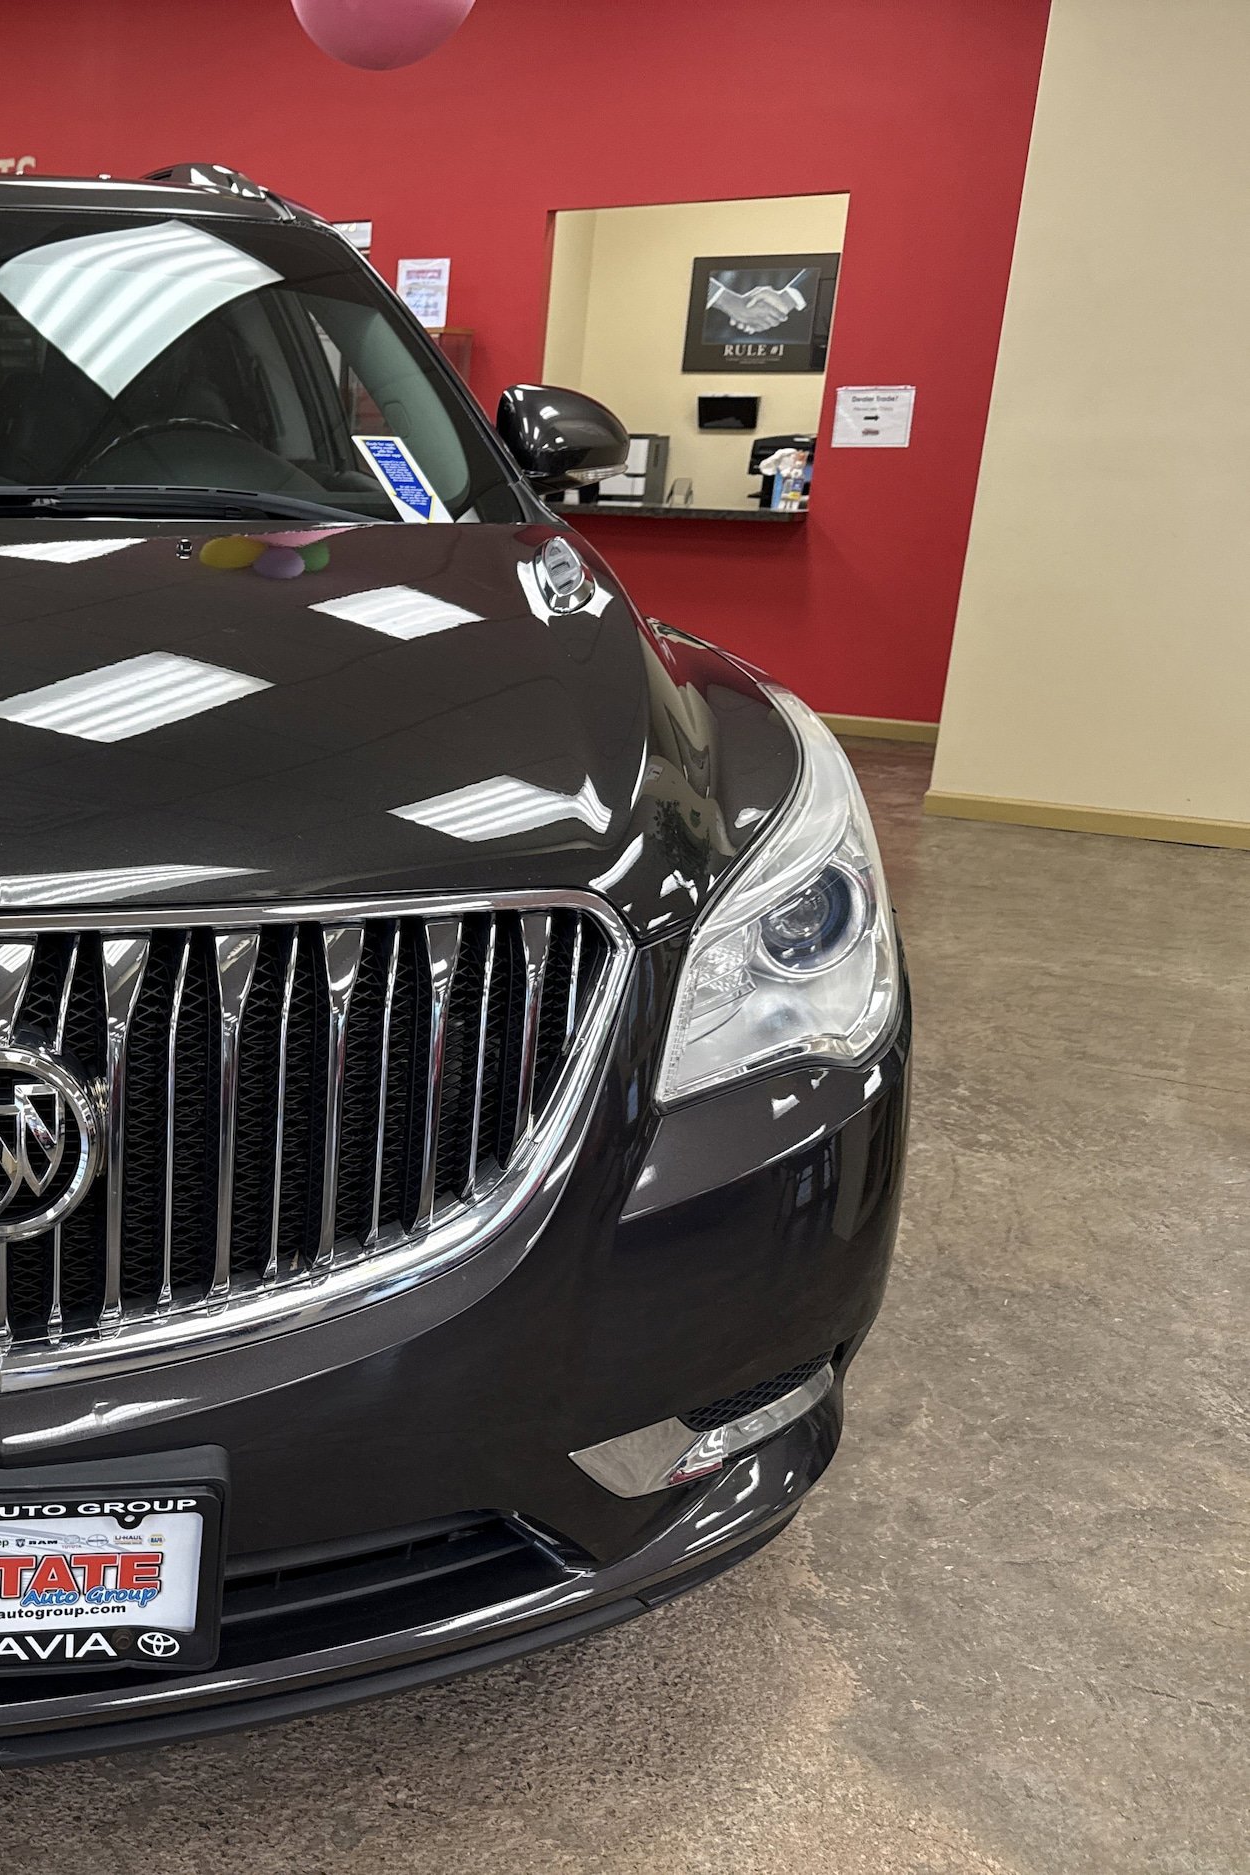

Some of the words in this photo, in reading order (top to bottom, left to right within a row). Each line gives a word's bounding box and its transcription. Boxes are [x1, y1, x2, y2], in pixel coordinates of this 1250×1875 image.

[723, 344, 767, 357] RULE
[77, 1499, 197, 1515] GROUP
[20, 1588, 78, 1608] Auto
[85, 1586, 158, 1608] Group
